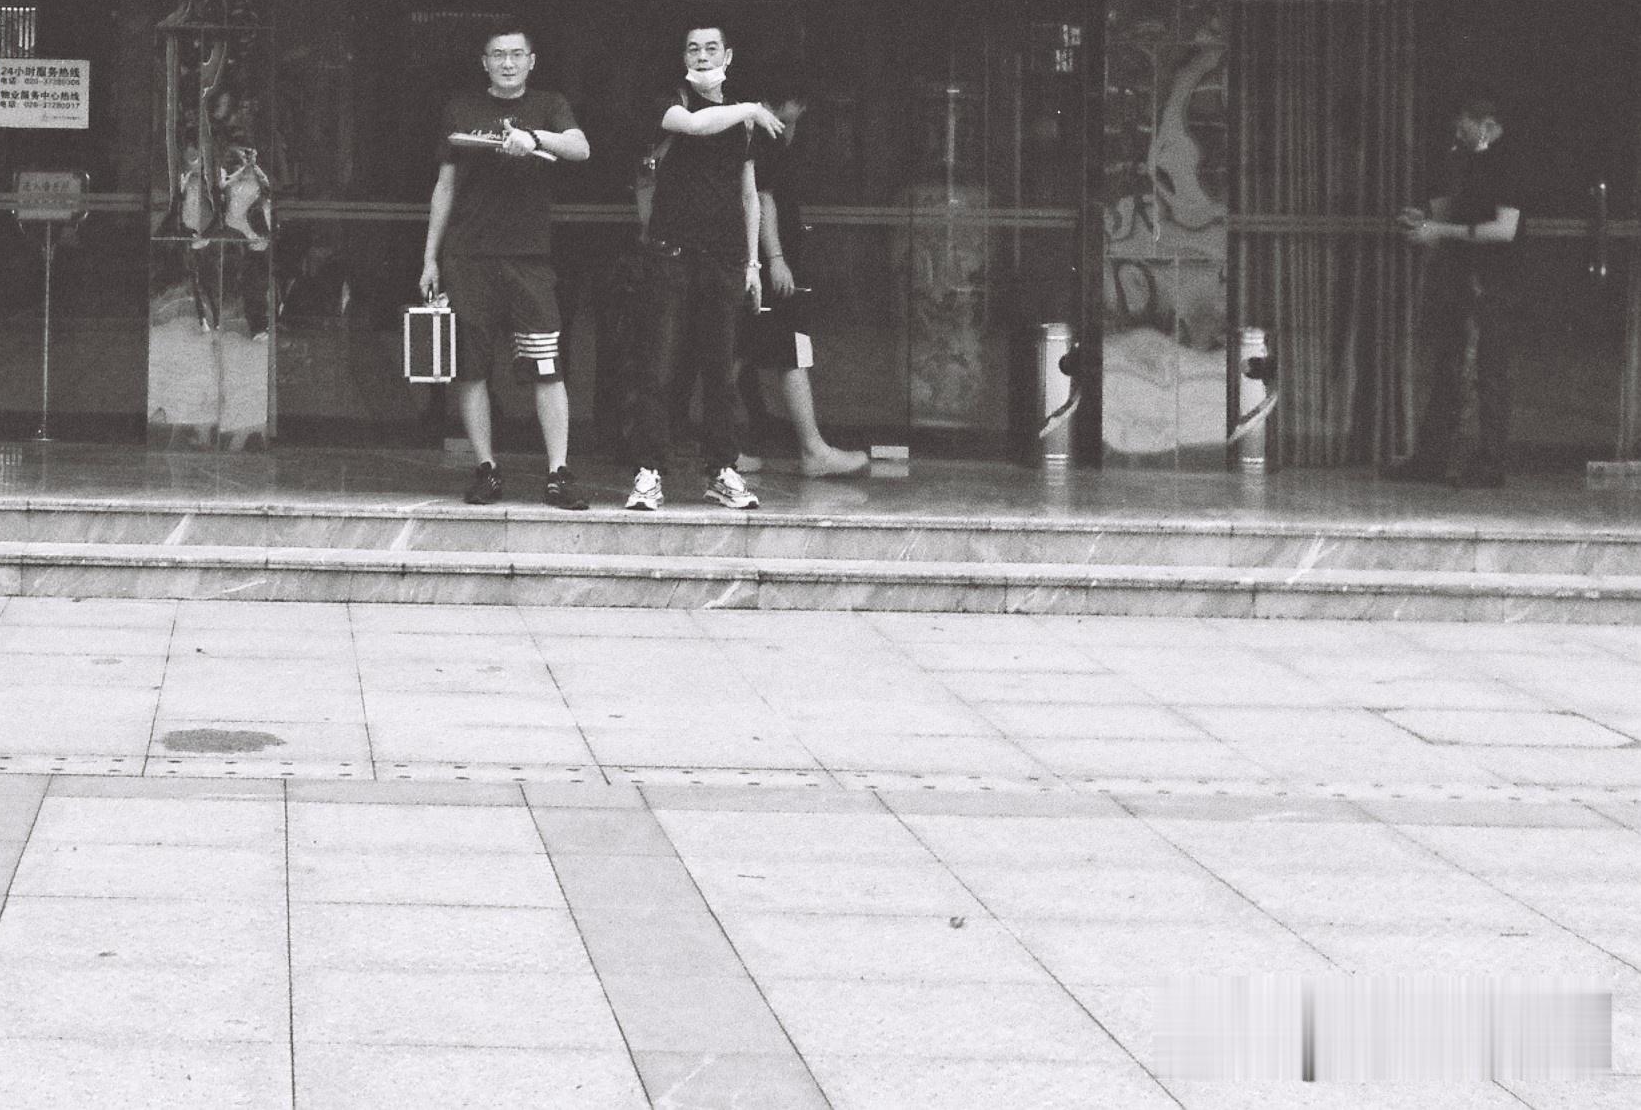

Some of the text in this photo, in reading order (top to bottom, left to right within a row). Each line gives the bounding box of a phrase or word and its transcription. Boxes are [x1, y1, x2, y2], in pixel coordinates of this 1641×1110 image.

[1, 66, 80, 78] 24小时服务热线
[0, 90, 80, 101] 物业服务中心热线
